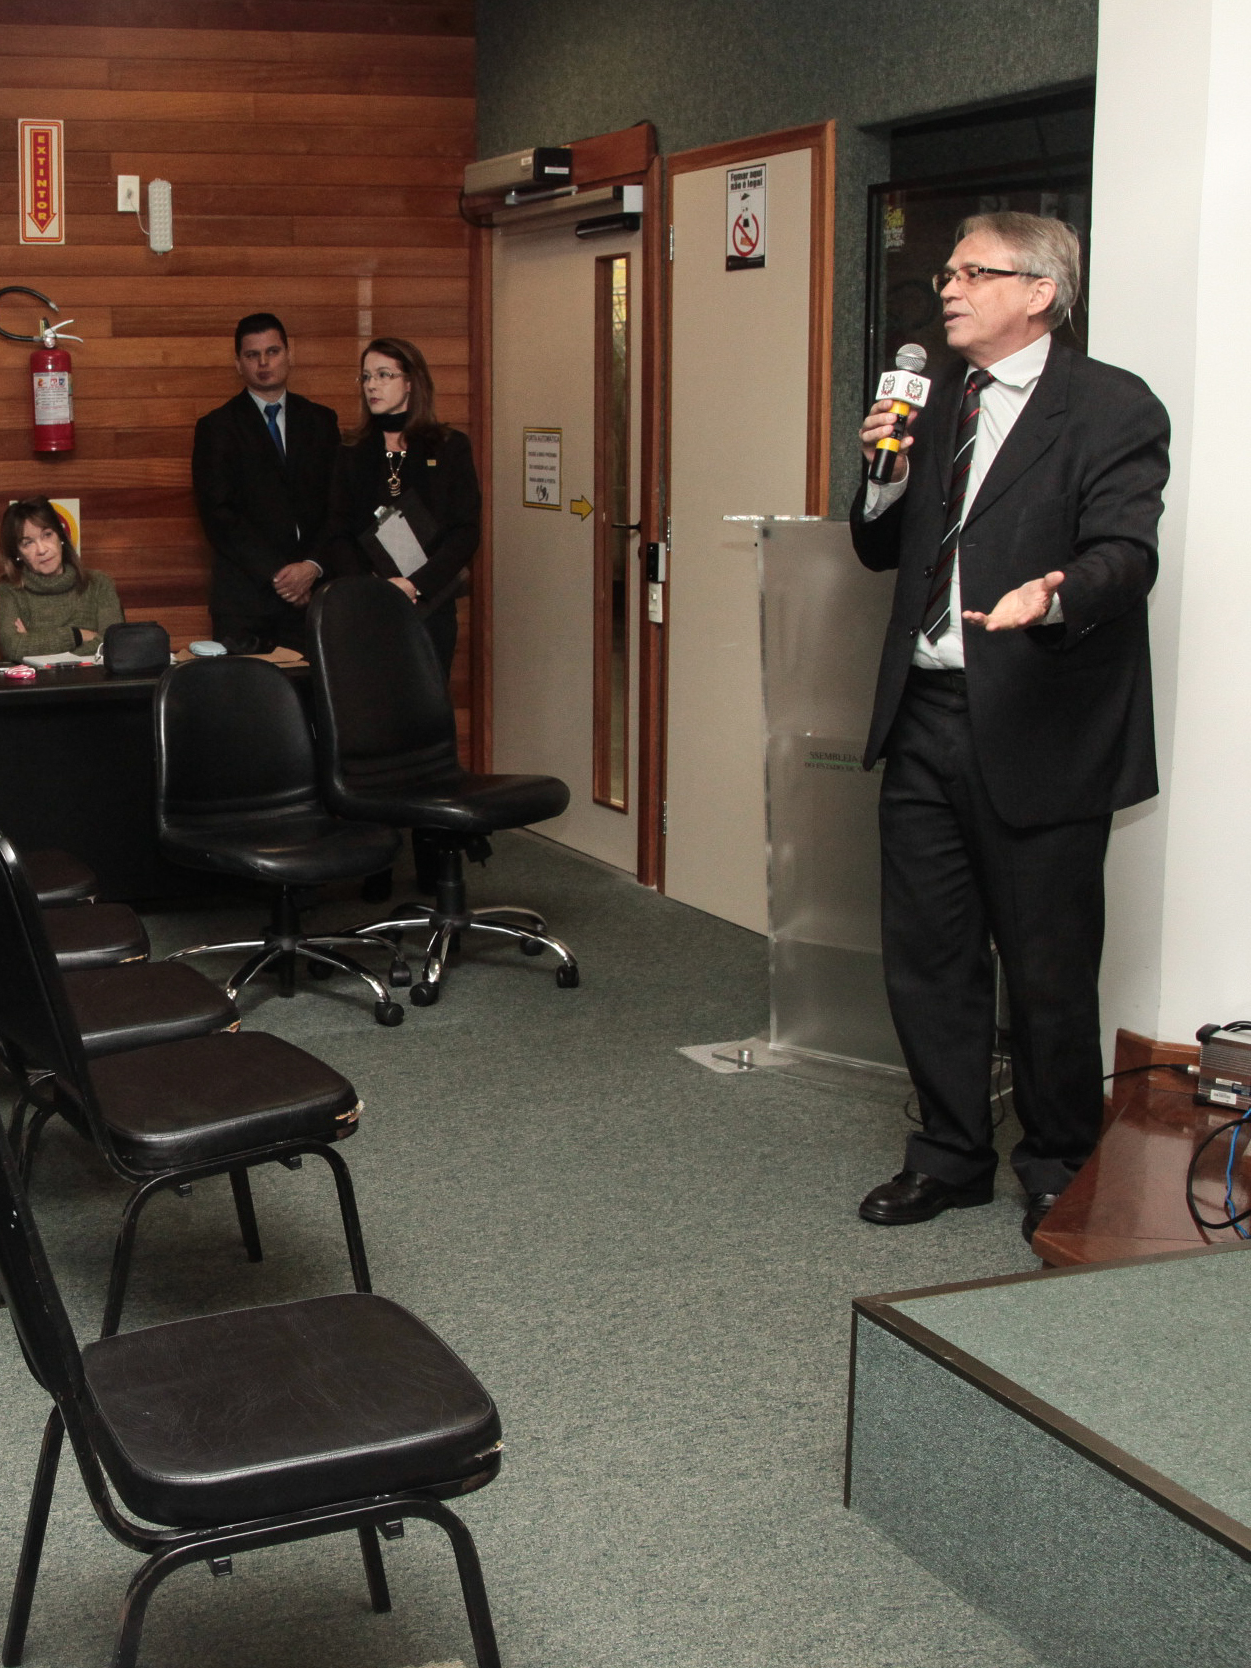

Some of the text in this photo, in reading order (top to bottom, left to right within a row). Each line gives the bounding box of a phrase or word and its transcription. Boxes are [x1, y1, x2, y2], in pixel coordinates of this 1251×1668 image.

[37, 135, 47, 220] EXTINTOR
[731, 168, 762, 181] Fumar aqui
[731, 181, 741, 190] não
[747, 177, 762, 188] legal
